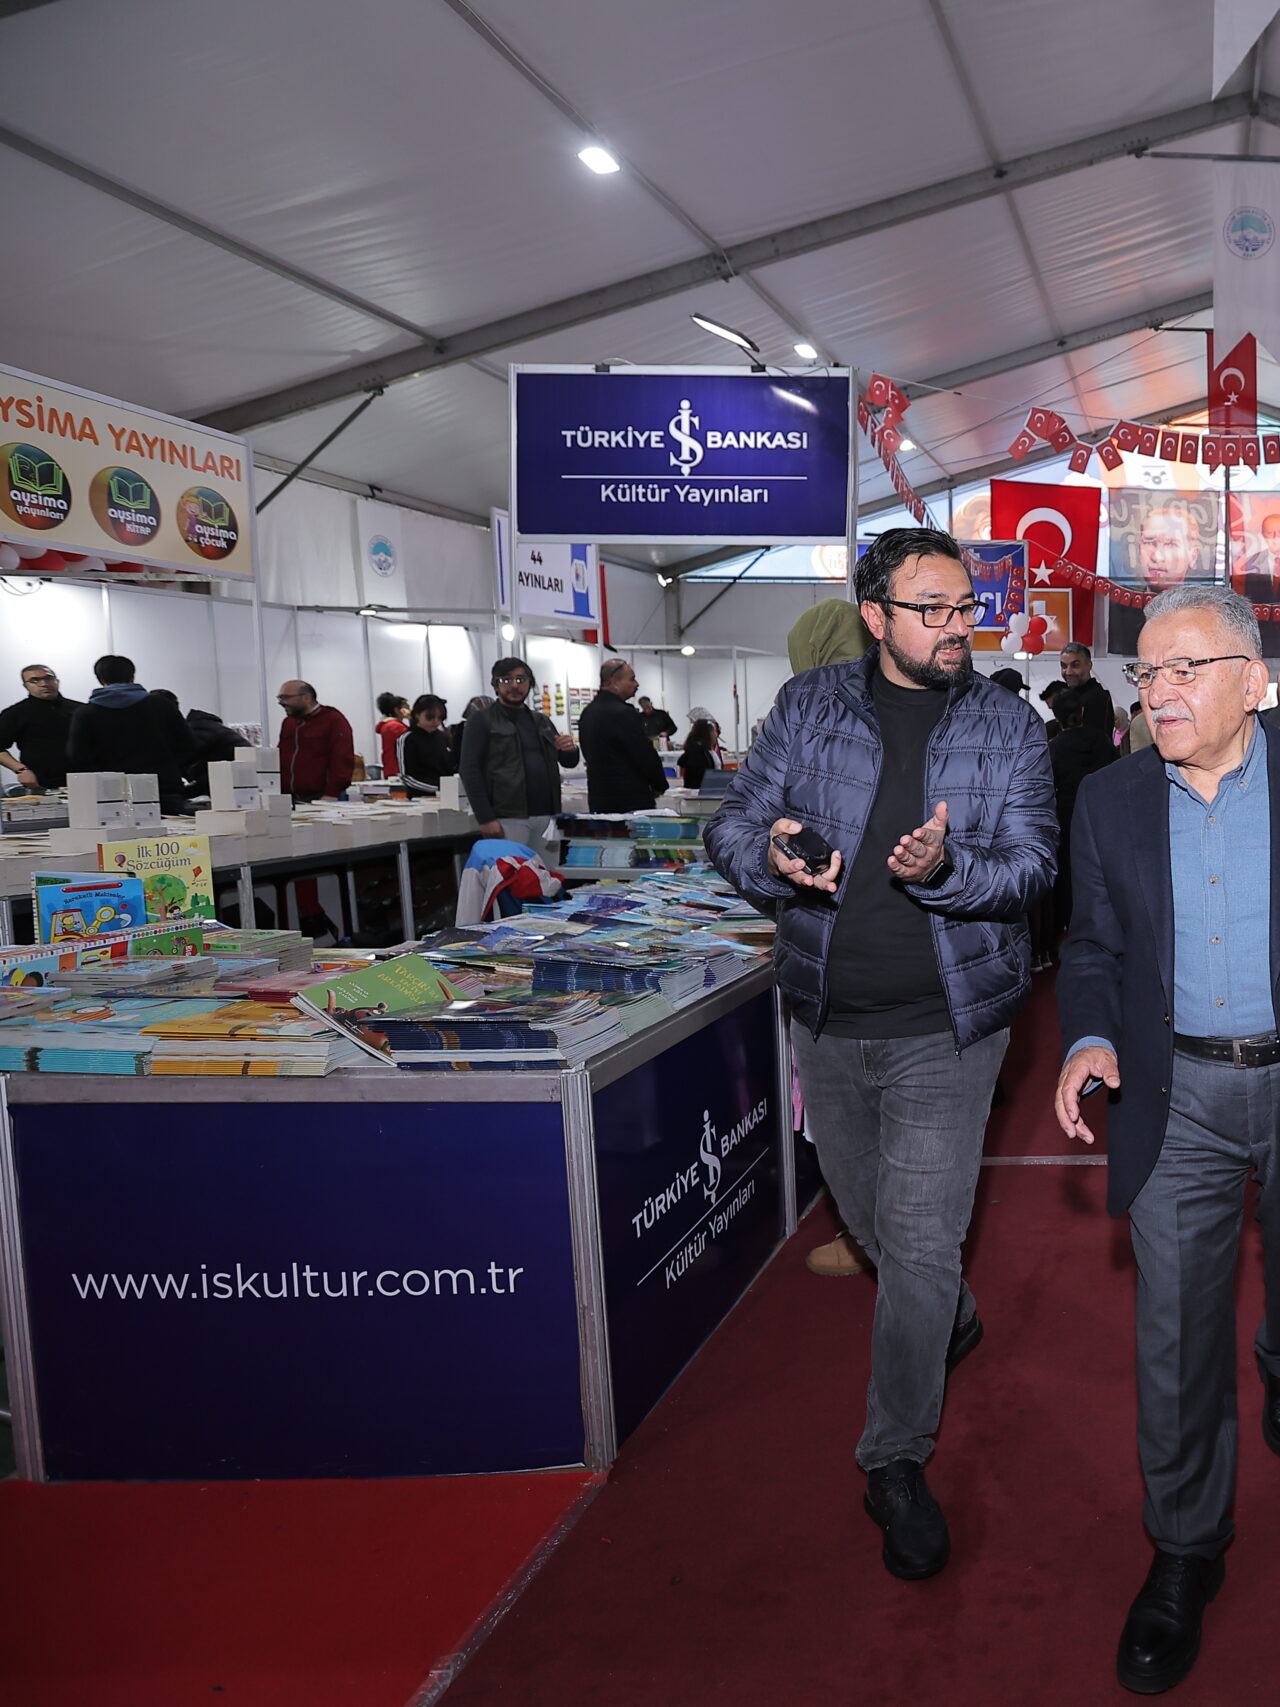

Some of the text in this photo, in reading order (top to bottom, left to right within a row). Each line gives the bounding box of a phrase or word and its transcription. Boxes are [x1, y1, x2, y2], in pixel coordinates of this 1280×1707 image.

[0, 396, 242, 482] YSİMA YAYINLARI
[561, 426, 664, 449] TÜRKİYE
[706, 431, 808, 450] BANKASI
[10, 488, 68, 511] aysima
[600, 484, 769, 506] Kültür Yayınları
[107, 507, 157, 527] aysima
[194, 524, 238, 541] aysima
[530, 551, 543, 565] 44
[517, 569, 564, 593] AYINLARI
[137, 841, 180, 858] İlk 100
[126, 857, 191, 872] Sözcüğüm
[631, 1161, 700, 1239] TÜRKİYE
[720, 1097, 768, 1158] BANKASI
[665, 1179, 755, 1290] Kültür Yayınları
[70, 1260, 525, 1301] www.iskultur.com.tr
